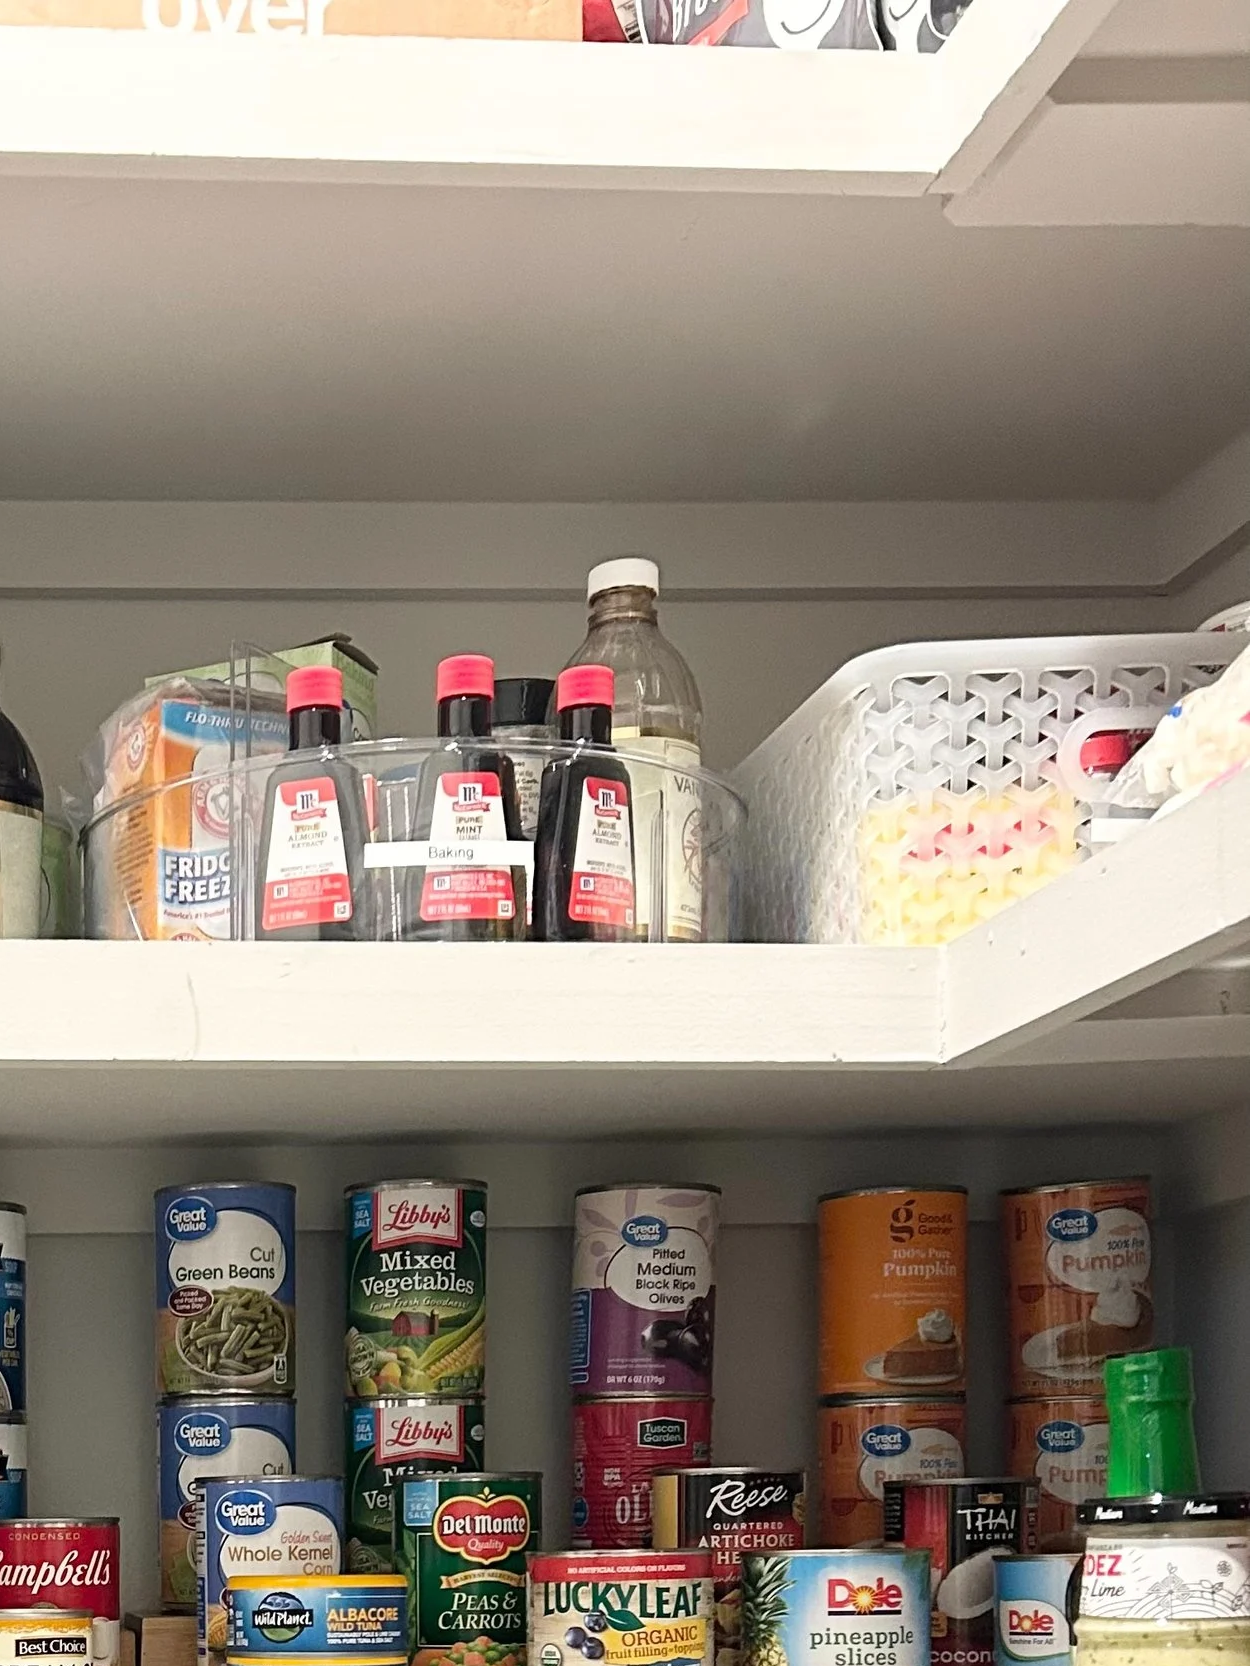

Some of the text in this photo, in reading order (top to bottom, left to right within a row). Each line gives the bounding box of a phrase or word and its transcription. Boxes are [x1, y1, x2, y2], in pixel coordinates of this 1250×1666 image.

[456, 825, 482, 835] MINT
[428, 846, 474, 862] Baking
[169, 1209, 206, 1223] Great
[354, 1210, 370, 1219] SEA
[382, 1200, 451, 1231] Libby's
[176, 1220, 207, 1232] Value
[354, 1218, 371, 1229] SALT
[250, 1247, 275, 1263] Cut
[380, 1251, 455, 1273] Mixed
[652, 1248, 685, 1261] Pitted
[1062, 1251, 1147, 1274] Pumpkin
[175, 1264, 276, 1281] Green Beans
[637, 1262, 696, 1277] Medium
[360, 1272, 475, 1299] Vegetables
[636, 1278, 696, 1292] Black Ripe
[649, 1292, 685, 1305] Olives
[644, 1423, 680, 1434] Tuscan
[643, 1433, 683, 1443] Garden
[705, 1479, 787, 1518] Reese
[441, 1514, 525, 1534] Del Monte
[713, 1521, 784, 1531] QUARTERED
[956, 1508, 1016, 1532] THAI
[698, 1533, 795, 1548] ARTICHOKE
[228, 1545, 334, 1562] Whole Kernel
[1091, 1580, 1125, 1598] Lime
[451, 1592, 517, 1610] PEAS &
[327, 1607, 398, 1622] ALBACORE
[438, 1611, 521, 1630] CARROTS
[622, 1625, 698, 1647] ORGANIC
[809, 1627, 914, 1650] pineapple
[834, 1648, 897, 1666] slices
